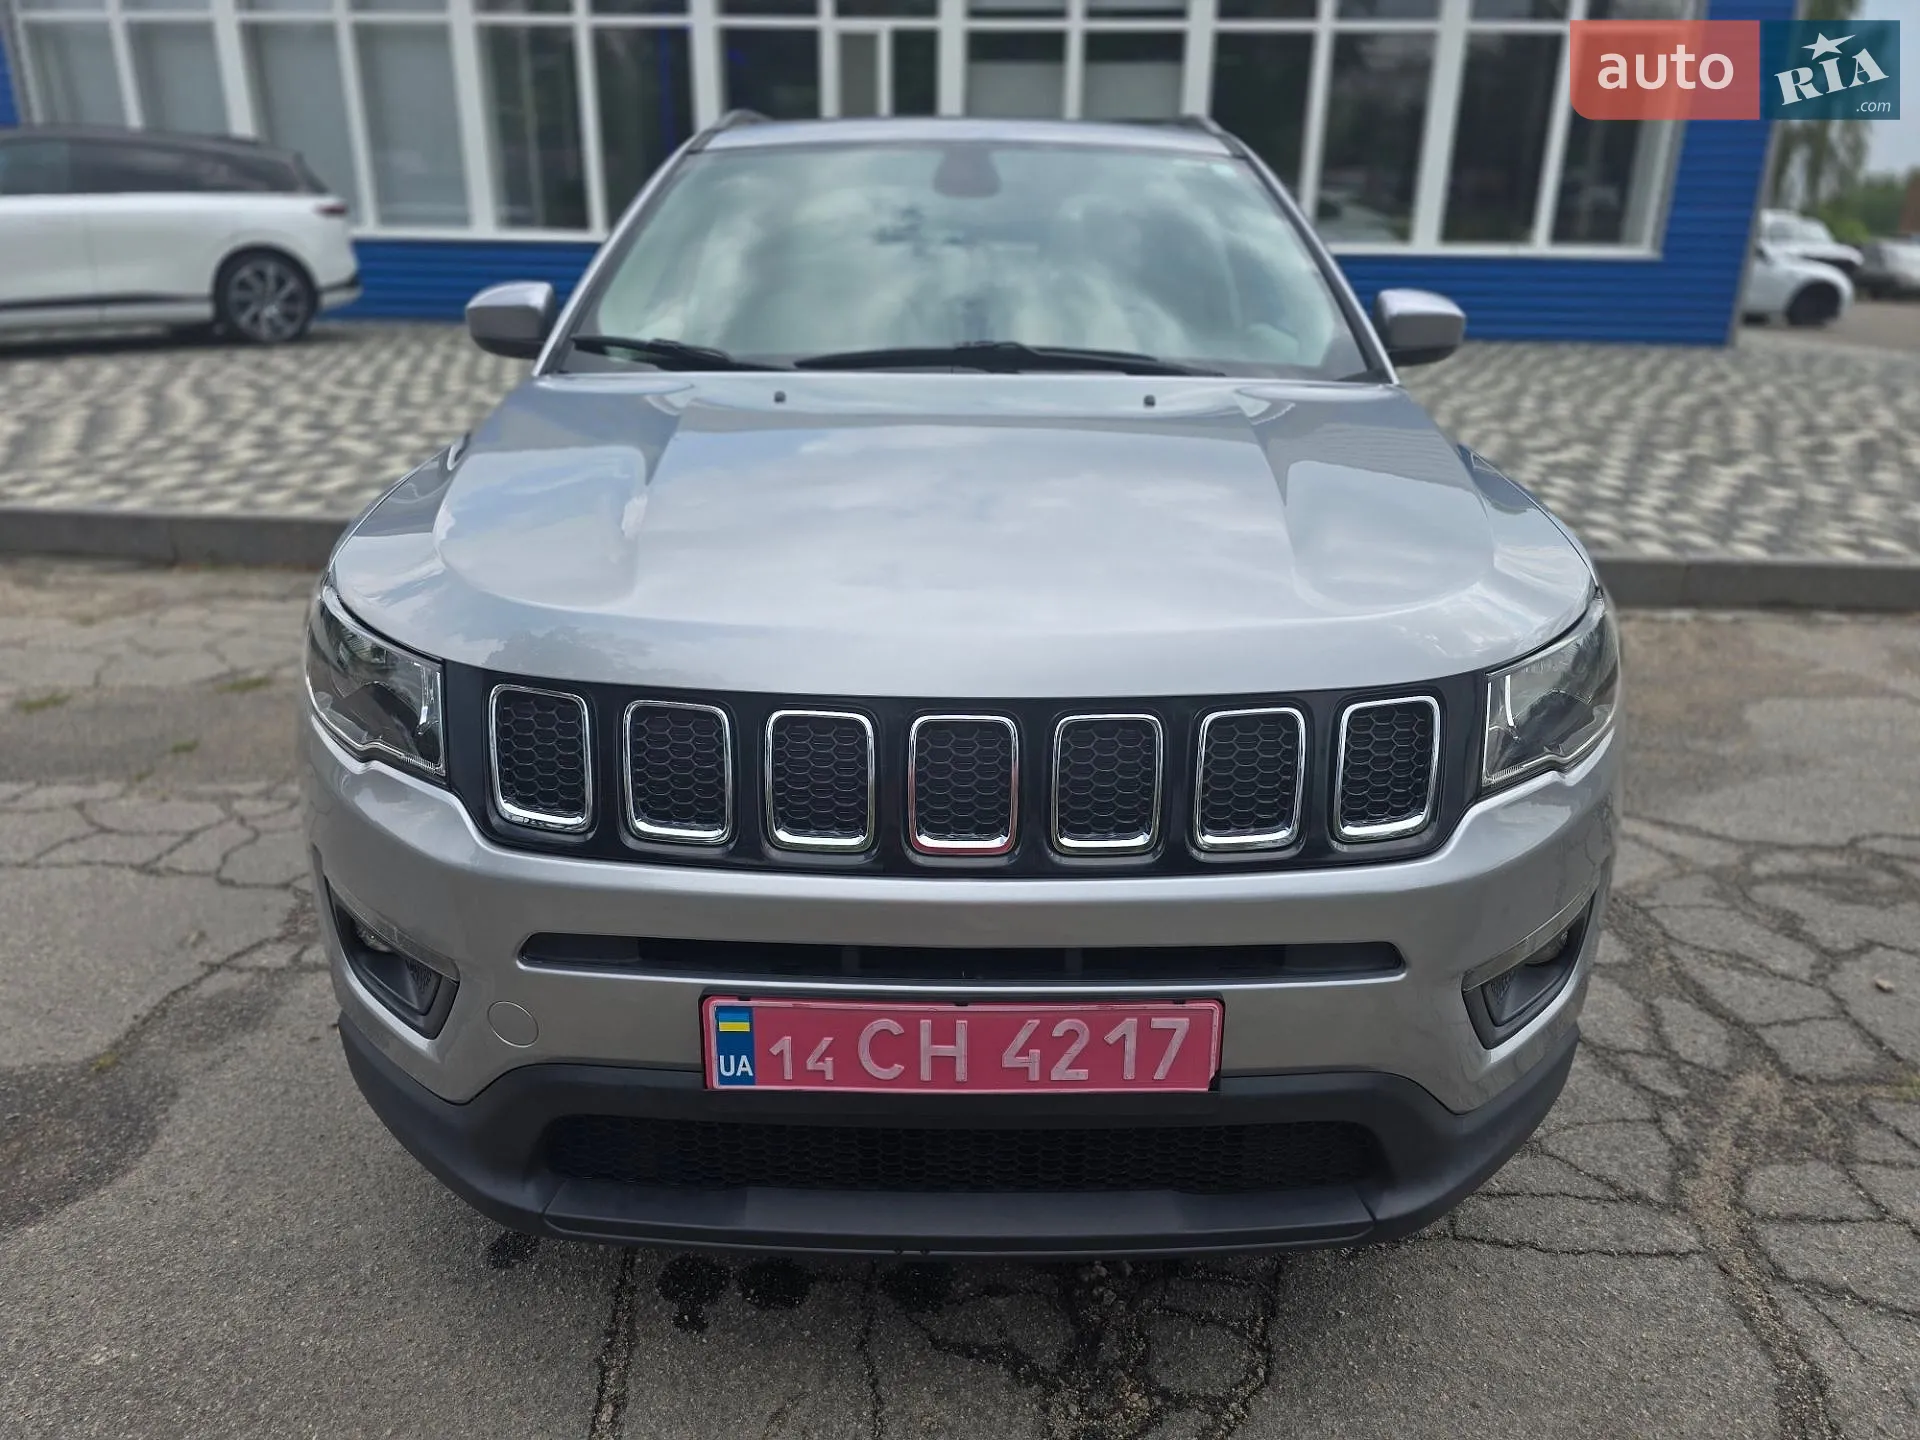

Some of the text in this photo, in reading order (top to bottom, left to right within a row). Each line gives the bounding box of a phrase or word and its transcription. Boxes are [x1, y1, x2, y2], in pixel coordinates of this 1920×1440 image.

[719, 1054, 754, 1078] UA
[768, 1017, 1191, 1082] 14 CH 4217
